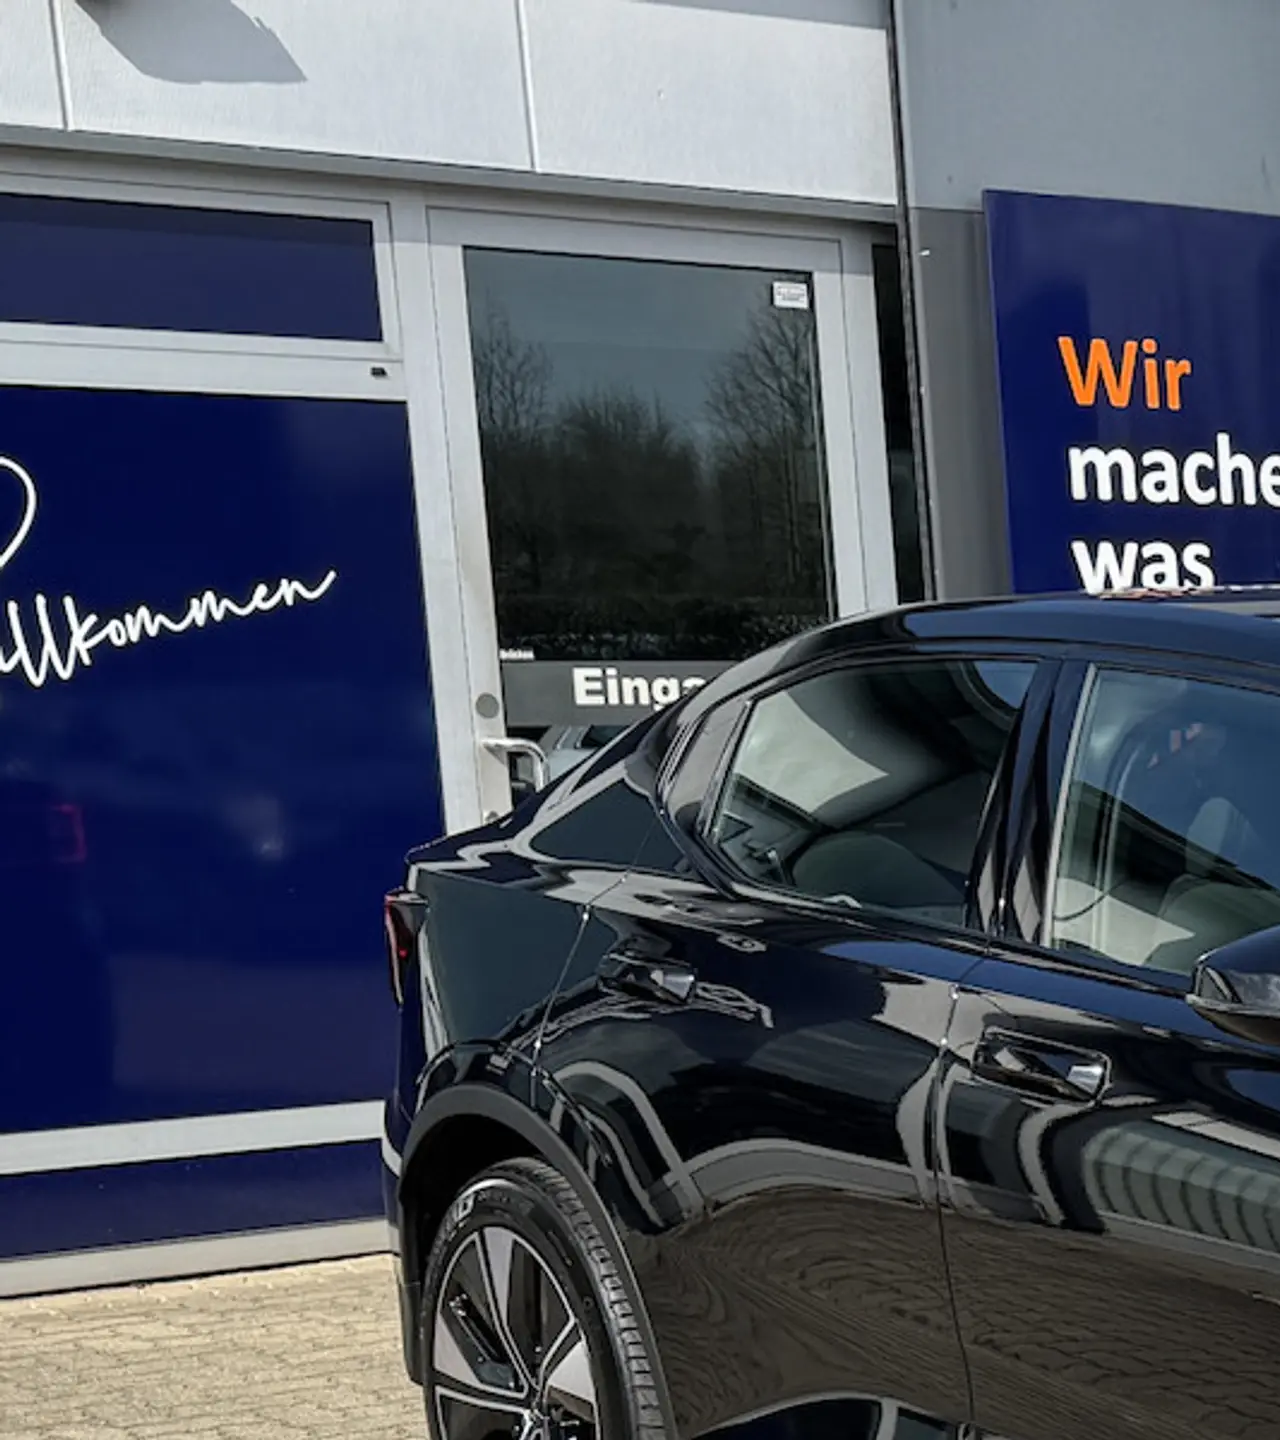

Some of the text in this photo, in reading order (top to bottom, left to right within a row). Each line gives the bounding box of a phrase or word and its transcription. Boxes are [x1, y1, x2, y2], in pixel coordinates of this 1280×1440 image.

[1058, 335, 1192, 411] Wir
[1071, 540, 1215, 596] was
[0, 570, 337, 687] llkommen
